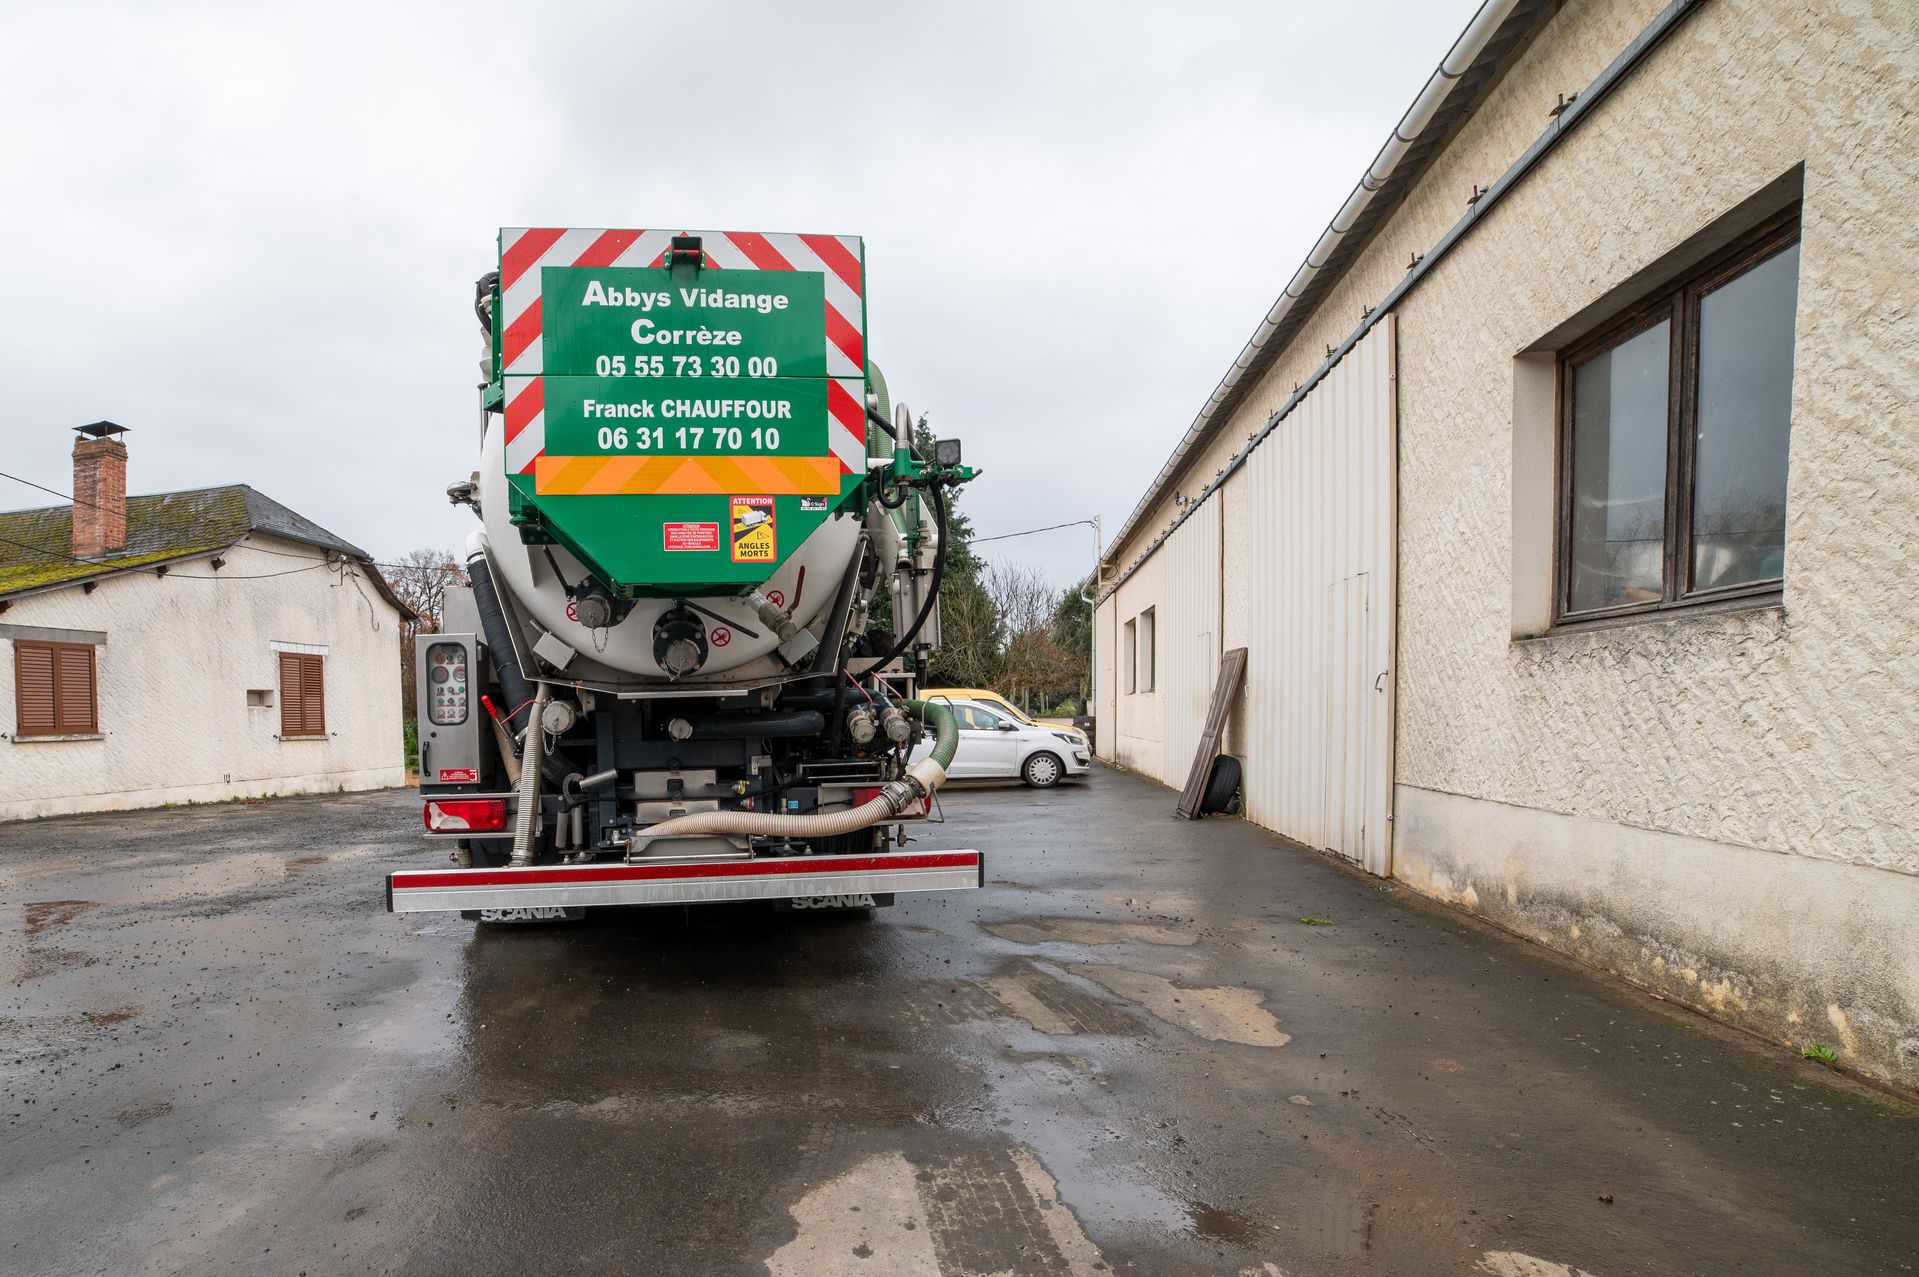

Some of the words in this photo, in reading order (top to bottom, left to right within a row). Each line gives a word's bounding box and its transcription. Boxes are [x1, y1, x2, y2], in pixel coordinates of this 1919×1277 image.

[582, 280, 671, 312] Abbys
[679, 288, 789, 314] Vidange
[631, 318, 742, 345] Corrèze
[595, 355, 626, 378] 05
[634, 355, 665, 378] 55
[672, 355, 702, 378] 73
[710, 356, 740, 378] 30
[748, 356, 778, 379] 00
[583, 399, 655, 418] Franck
[661, 399, 792, 419] CHAUFFOUR
[597, 427, 628, 450] 06
[636, 427, 664, 450] 31
[675, 427, 704, 450] 17
[712, 427, 742, 450] 70
[751, 427, 780, 450] 10
[738, 542, 770, 550] ANGLES
[791, 894, 877, 909] SCANIA
[480, 906, 567, 921] SCANIA
